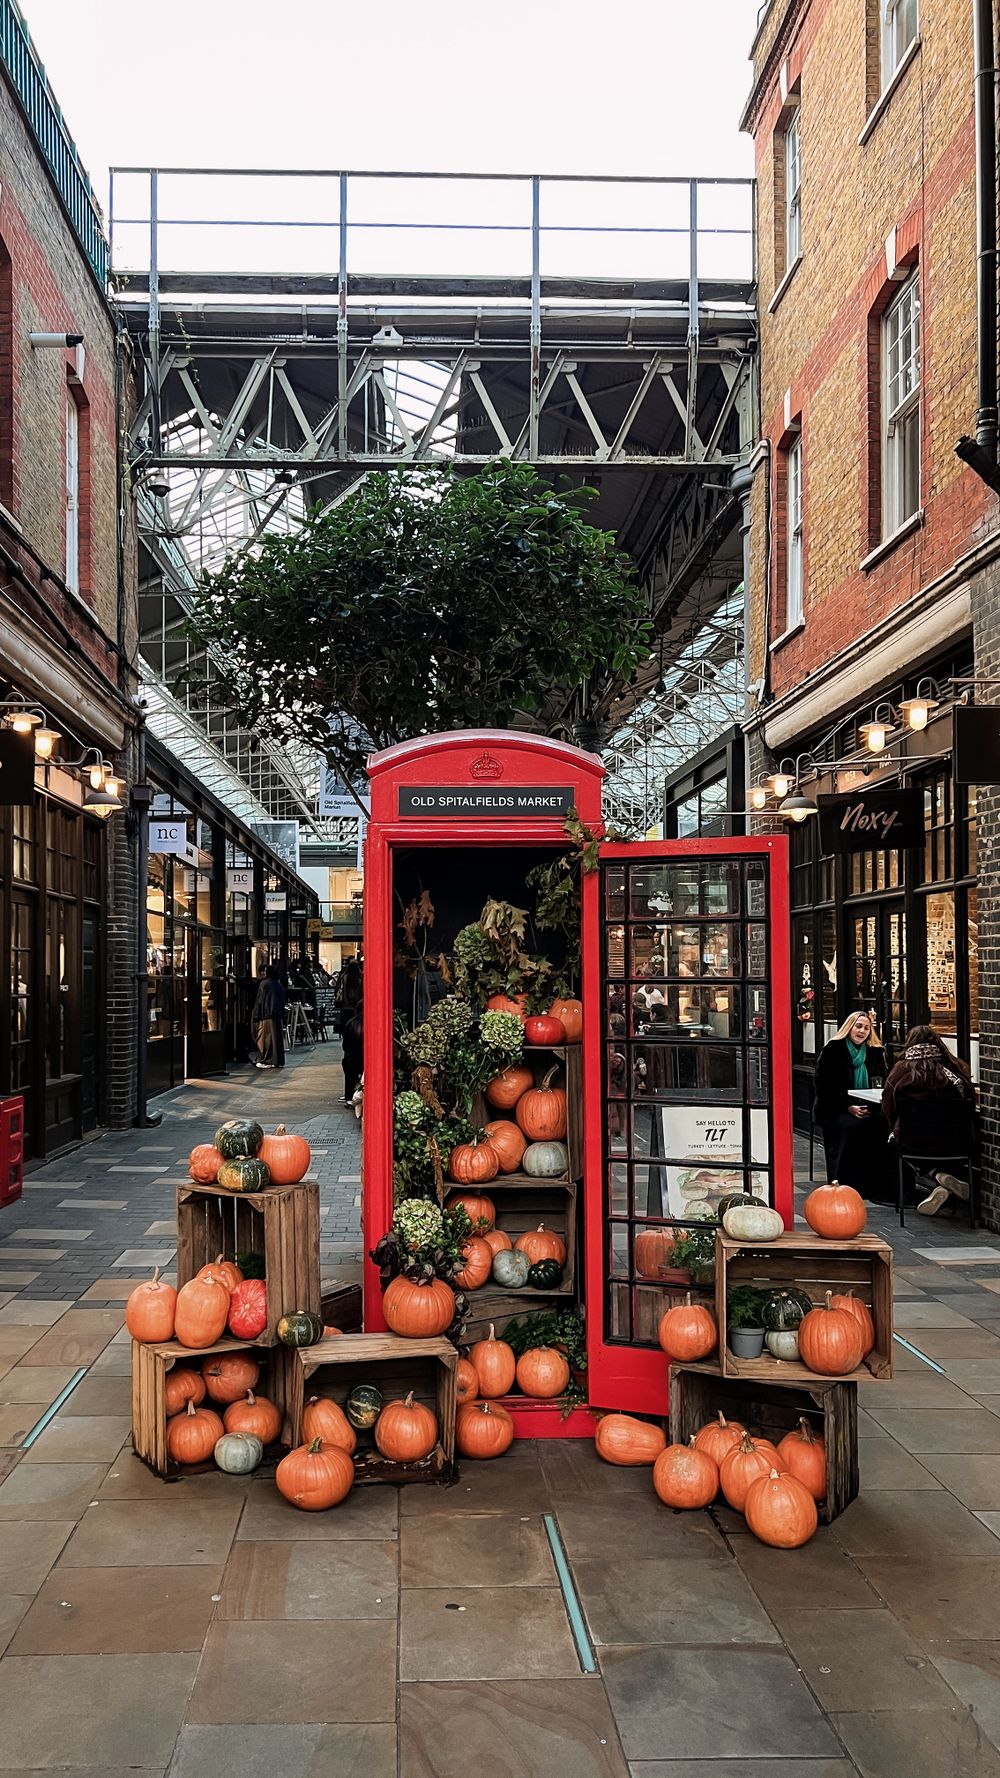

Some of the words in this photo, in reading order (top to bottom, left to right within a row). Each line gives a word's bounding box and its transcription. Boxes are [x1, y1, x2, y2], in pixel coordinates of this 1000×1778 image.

[411, 796, 435, 807] OLD
[438, 796, 514, 807] SPITALFIELDS
[517, 796, 563, 807] MARKET
[840, 802, 898, 839] Noxy
[157, 827, 178, 840] nc
[233, 873, 248, 882] nc
[705, 1128, 728, 1142] TLT
